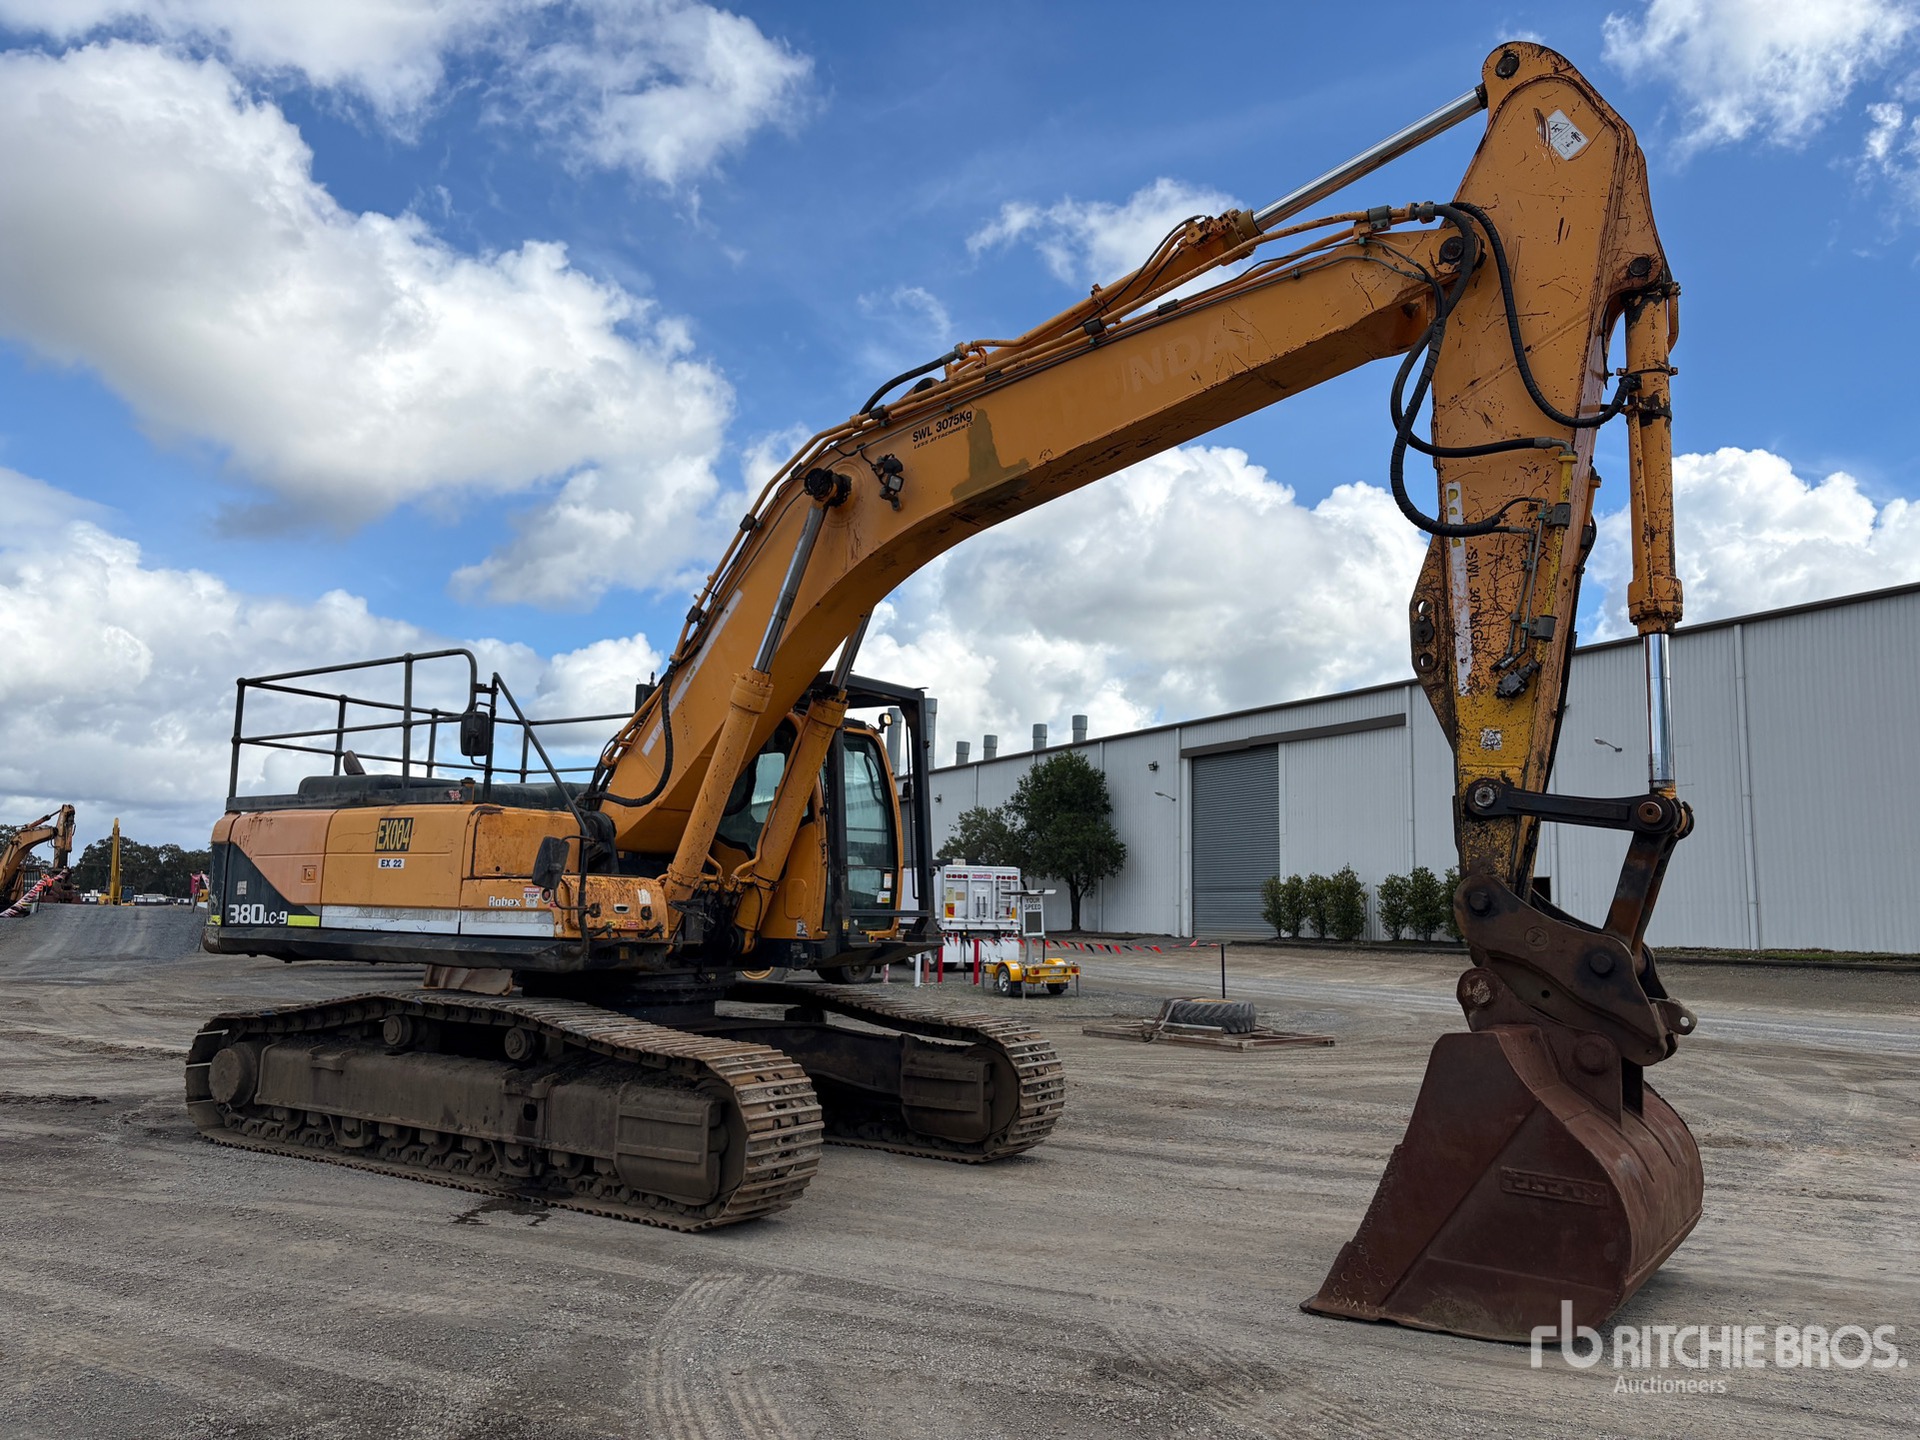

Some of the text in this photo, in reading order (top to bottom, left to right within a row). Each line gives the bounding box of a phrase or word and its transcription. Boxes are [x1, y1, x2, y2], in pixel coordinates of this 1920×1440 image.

[912, 411, 973, 443] SWL 3075Kg
[913, 421, 974, 450] LESS ATTACHMENTS
[1467, 547, 1481, 583] SWL
[375, 818, 412, 851] EX004
[380, 859, 403, 868] EX 22
[488, 895, 521, 907] Robex
[1024, 903, 1042, 911] SPEED
